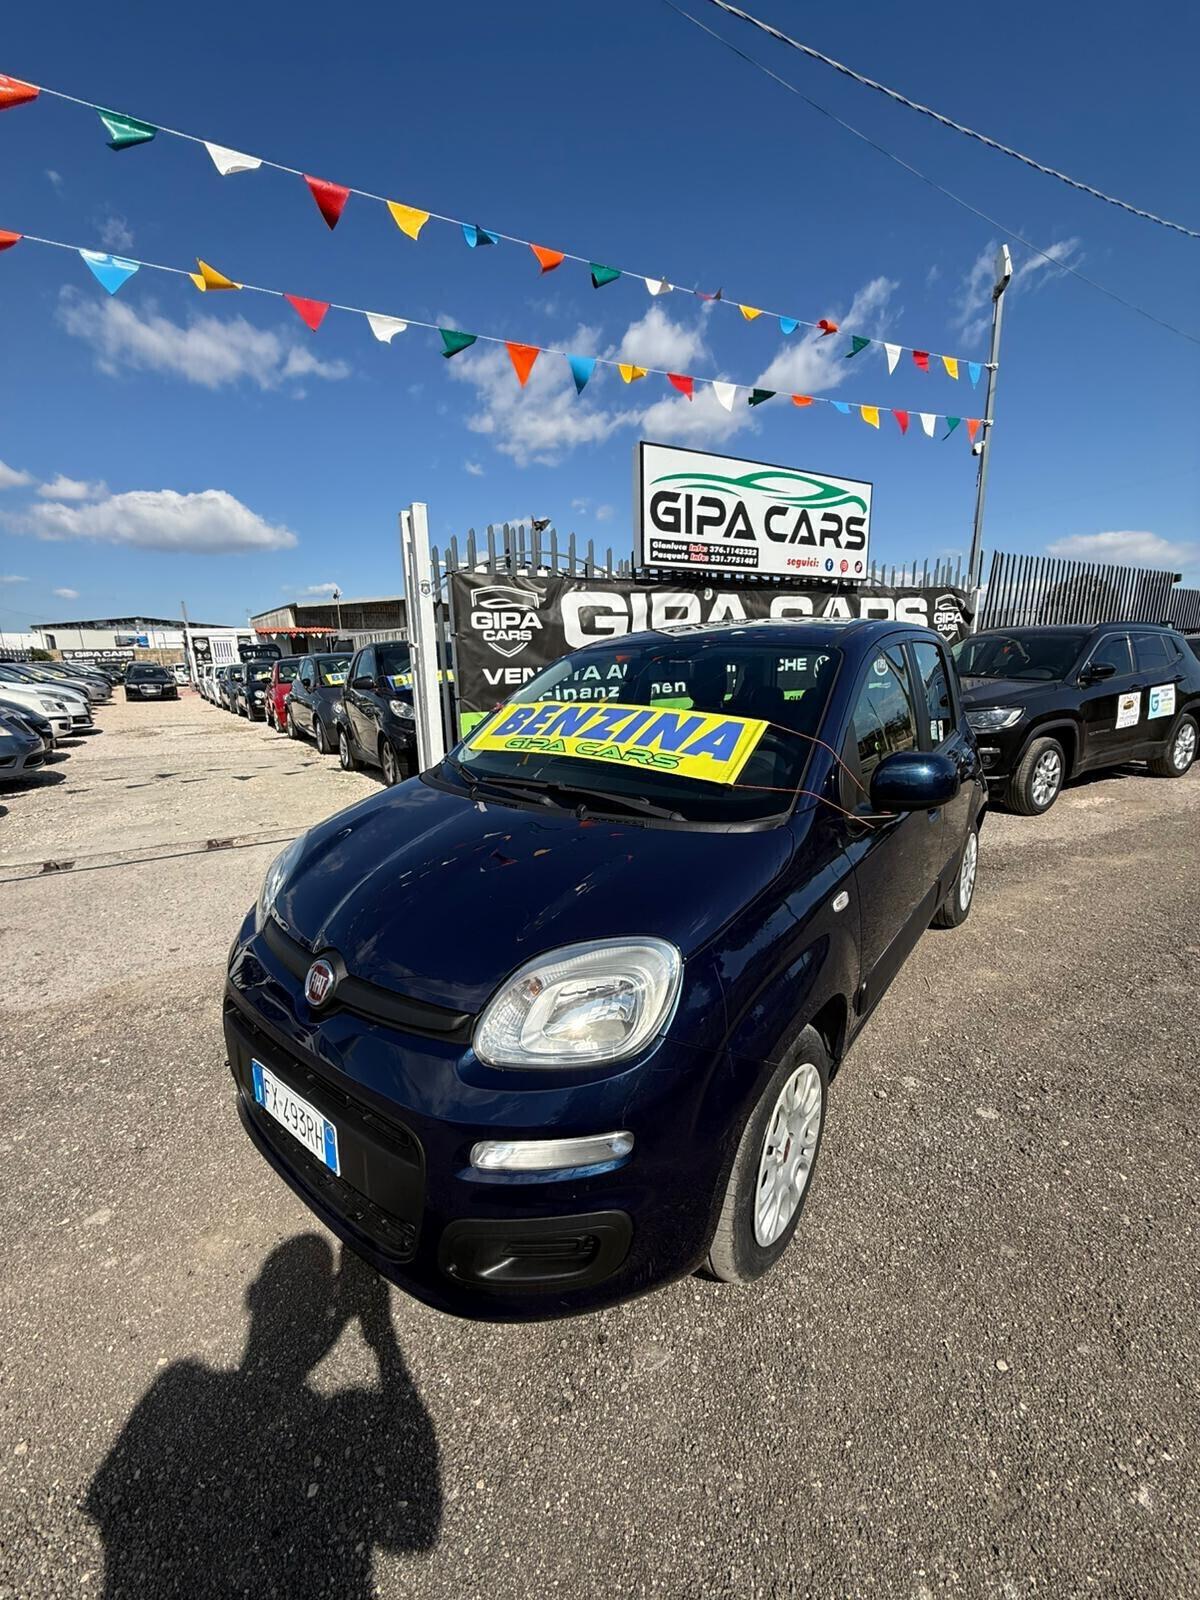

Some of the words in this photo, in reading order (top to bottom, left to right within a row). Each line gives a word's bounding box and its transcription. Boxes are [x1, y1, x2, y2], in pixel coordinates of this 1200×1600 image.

[650, 490, 757, 541] GIPA
[764, 505, 867, 551] CARS
[652, 540, 687, 551] Gianluca
[652, 550, 688, 561] Pasquale
[786, 557, 820, 568] seguici:
[470, 611, 543, 630] GIPA
[933, 612, 964, 624] GIPA
[482, 630, 532, 641] CARS
[491, 705, 745, 761] BENZINA
[504, 737, 566, 752] GIPA
[574, 742, 683, 770] CARS
[310, 971, 328, 996] FIAT
